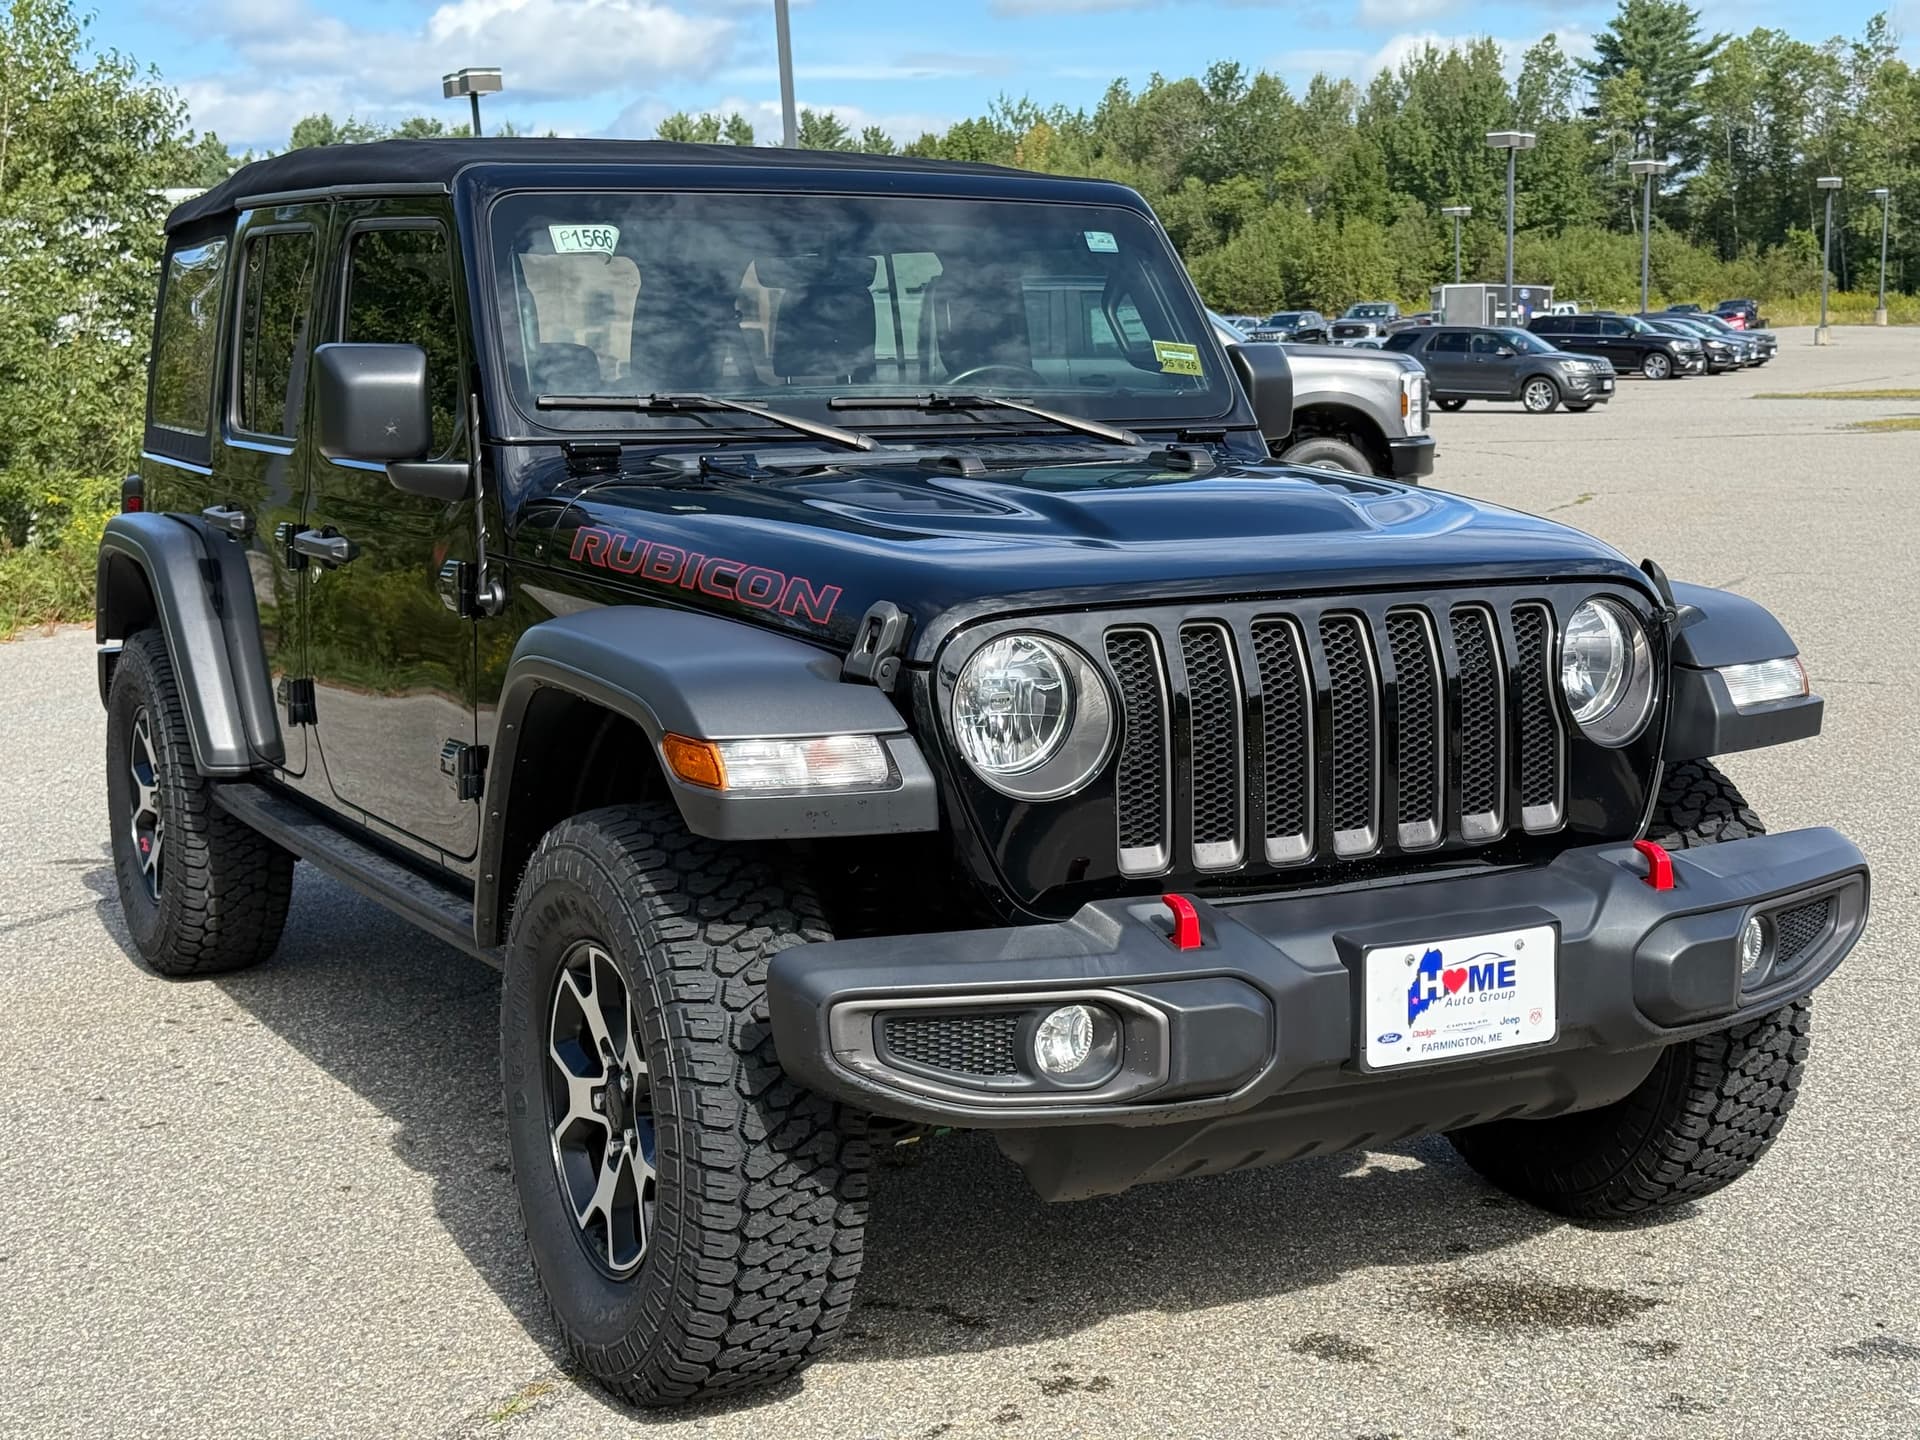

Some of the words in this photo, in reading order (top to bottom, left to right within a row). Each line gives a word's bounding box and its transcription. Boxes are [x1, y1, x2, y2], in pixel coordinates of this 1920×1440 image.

[560, 229, 613, 249] P1566
[569, 525, 843, 625] RUBICON
[1445, 995, 1474, 1008] Auto
[1479, 990, 1516, 1003] Group
[1499, 1016, 1520, 1026] Jeep
[1412, 1028, 1437, 1039] Dodge
[1421, 1035, 1487, 1053] FARMINGTON,
[1488, 1032, 1503, 1043] ME
